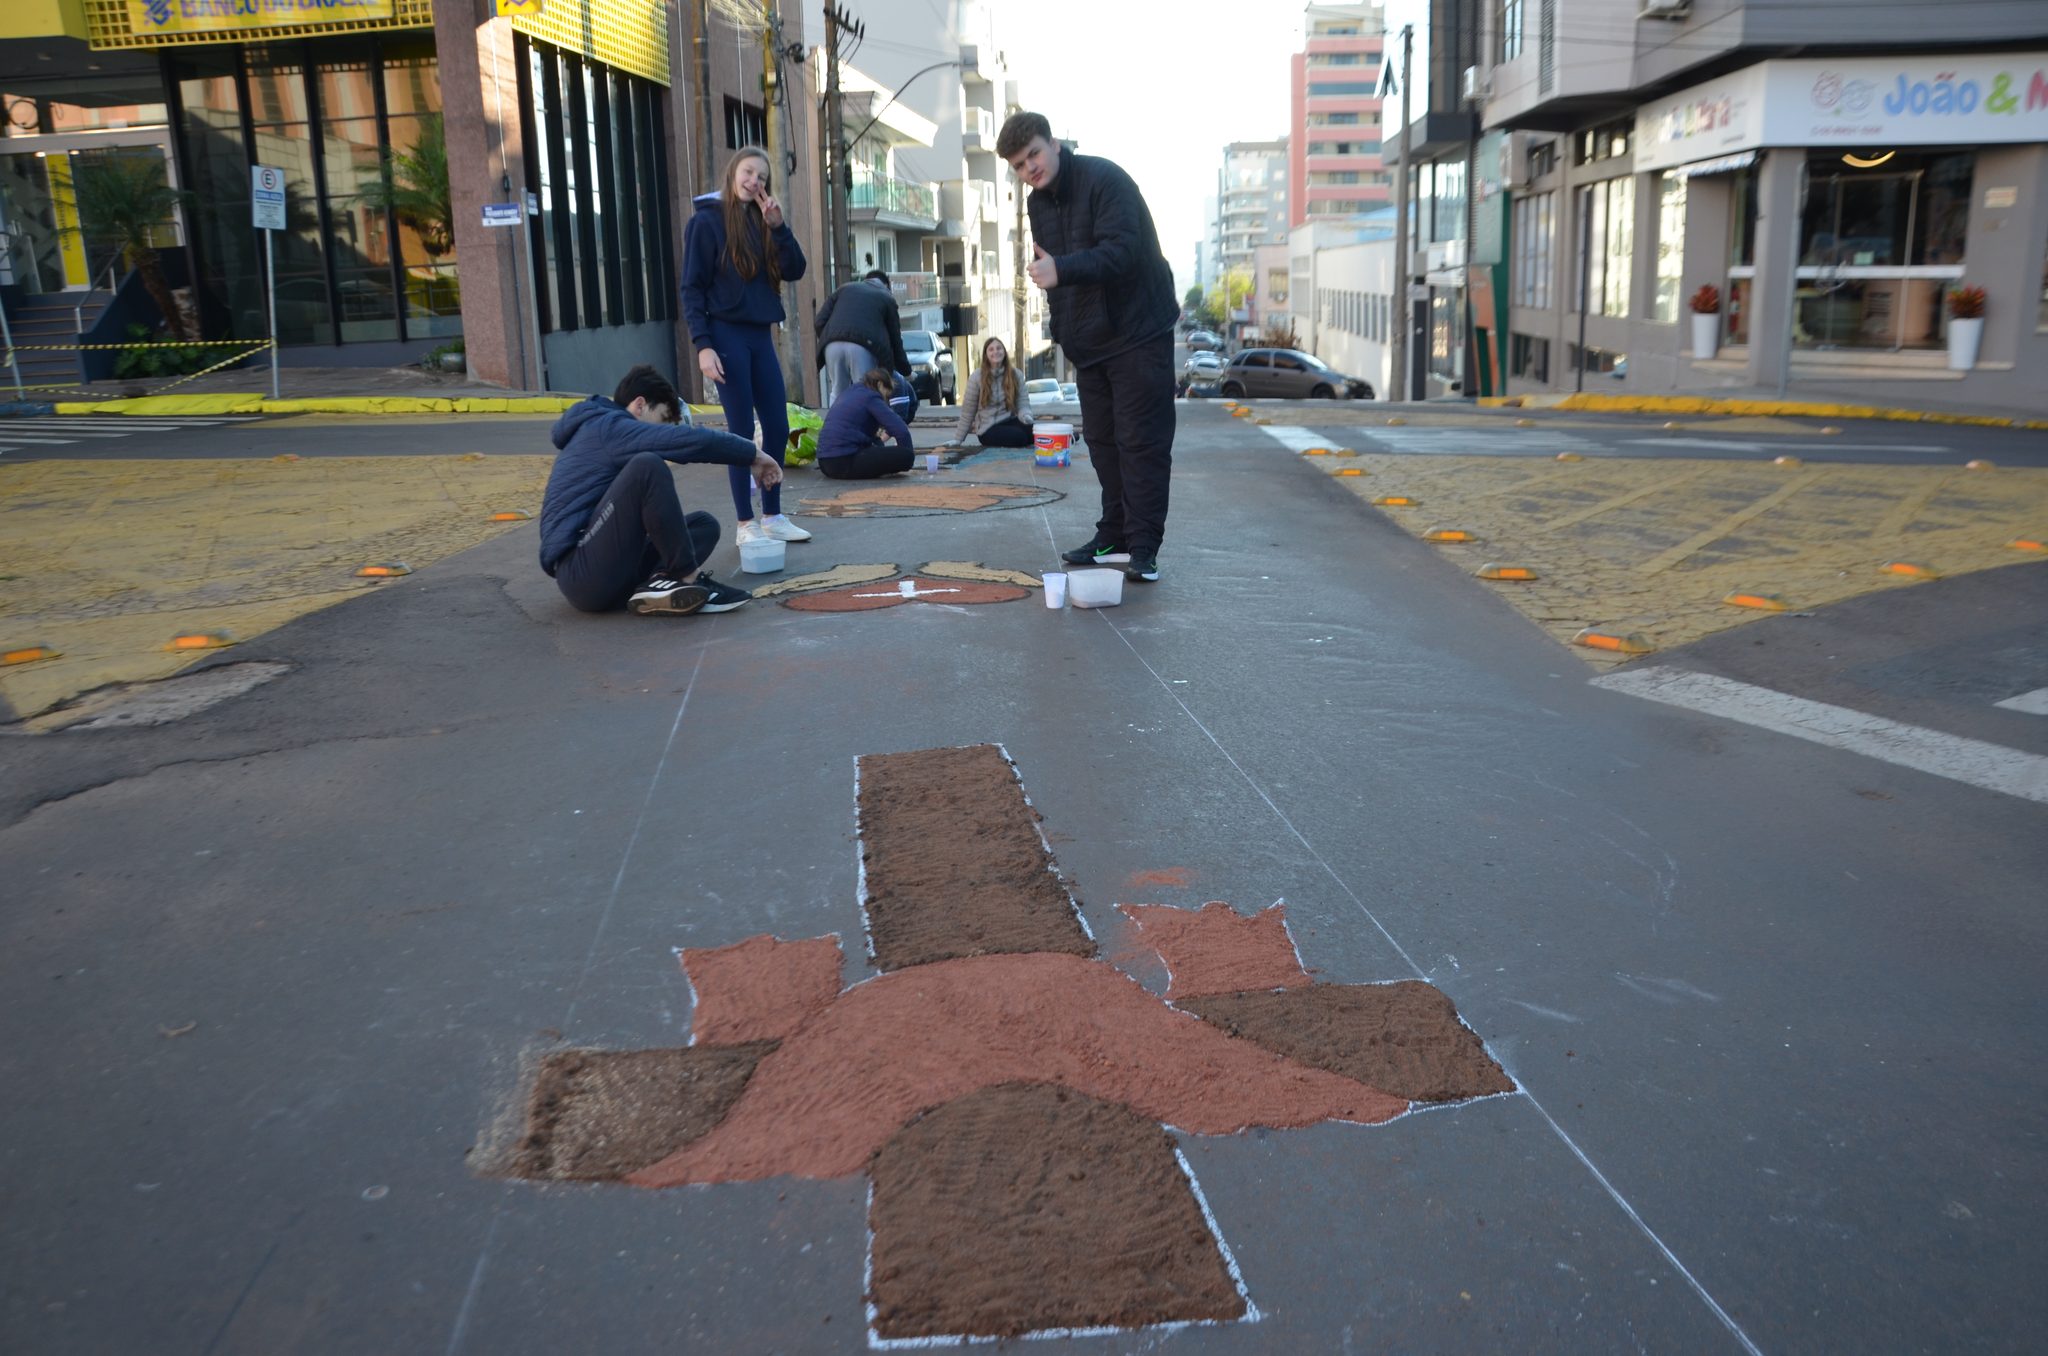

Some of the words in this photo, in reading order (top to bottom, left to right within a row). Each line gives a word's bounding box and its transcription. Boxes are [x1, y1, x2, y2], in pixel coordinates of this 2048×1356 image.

[1884, 70, 1980, 116] João
[1985, 70, 2020, 116] &
[265, 173, 272, 185] E
